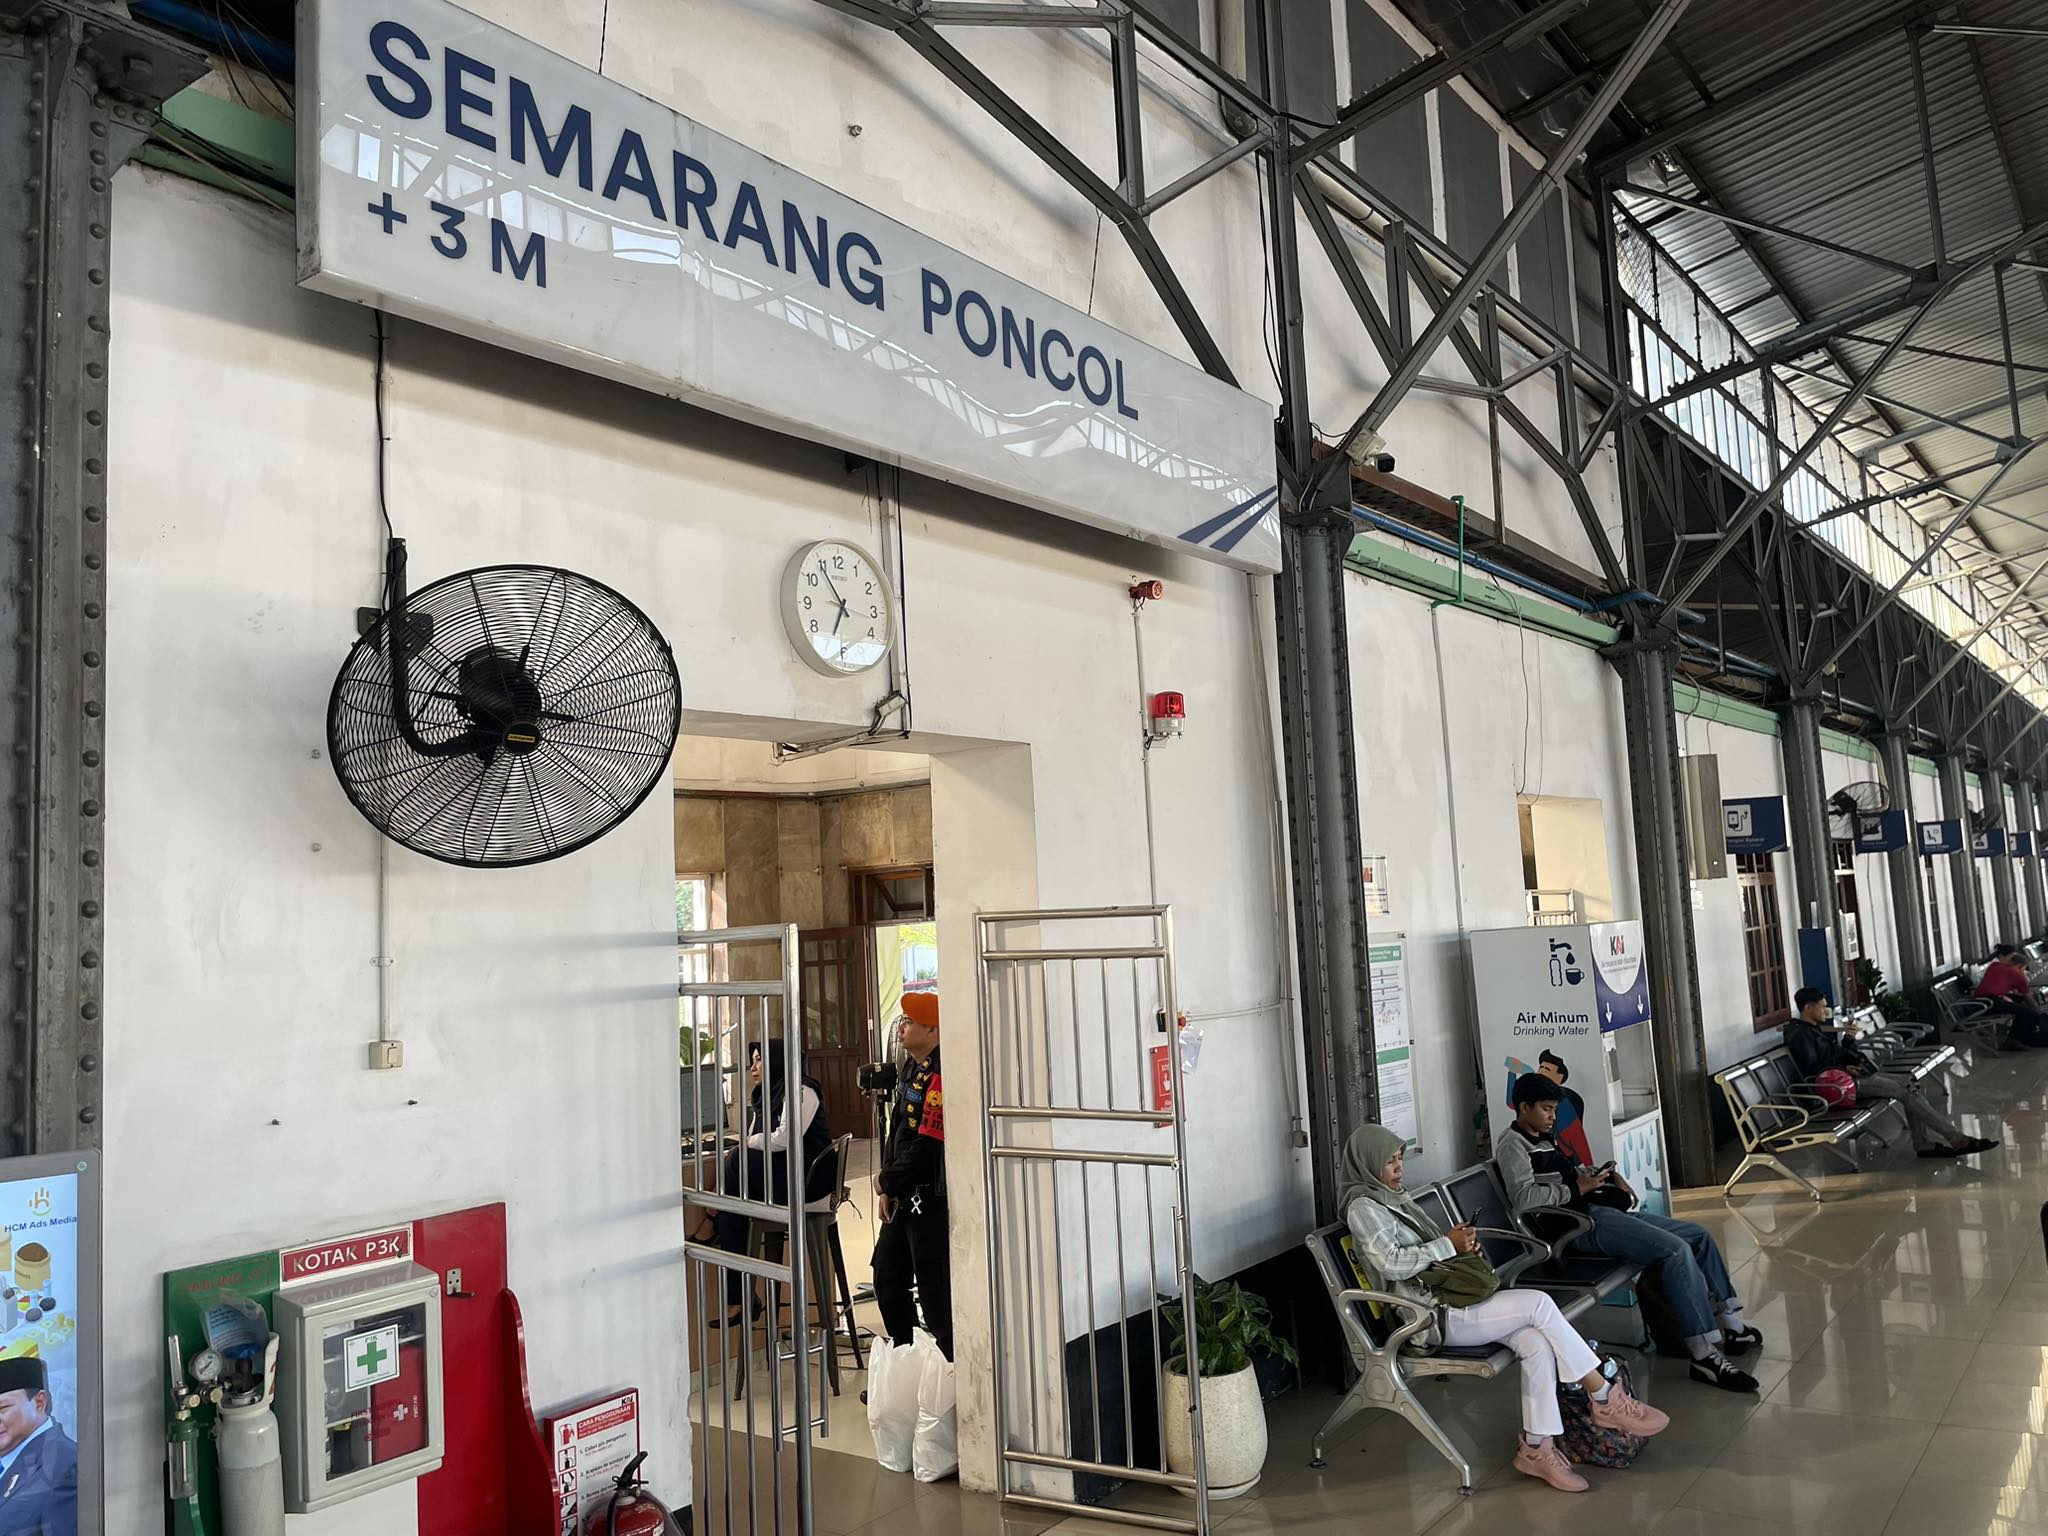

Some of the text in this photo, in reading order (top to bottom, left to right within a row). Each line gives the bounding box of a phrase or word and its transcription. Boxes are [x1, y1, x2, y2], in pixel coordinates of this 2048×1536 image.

[366, 21, 1138, 421] SEMARANG PONCOL
[832, 556, 844, 570] 12
[853, 565, 858, 578] 1
[806, 572, 818, 587] 10
[865, 581, 873, 595] 2
[803, 596, 812, 610] 9
[870, 605, 878, 619] 3
[810, 619, 819, 633] 8
[867, 626, 875, 639] 4
[1516, 1011, 1589, 1023] Air Minum
[1513, 1025, 1589, 1037] Drinking Water
[4, 1215, 78, 1233] HCM Ads Media
[293, 1235, 401, 1273] KOTAK P3K
